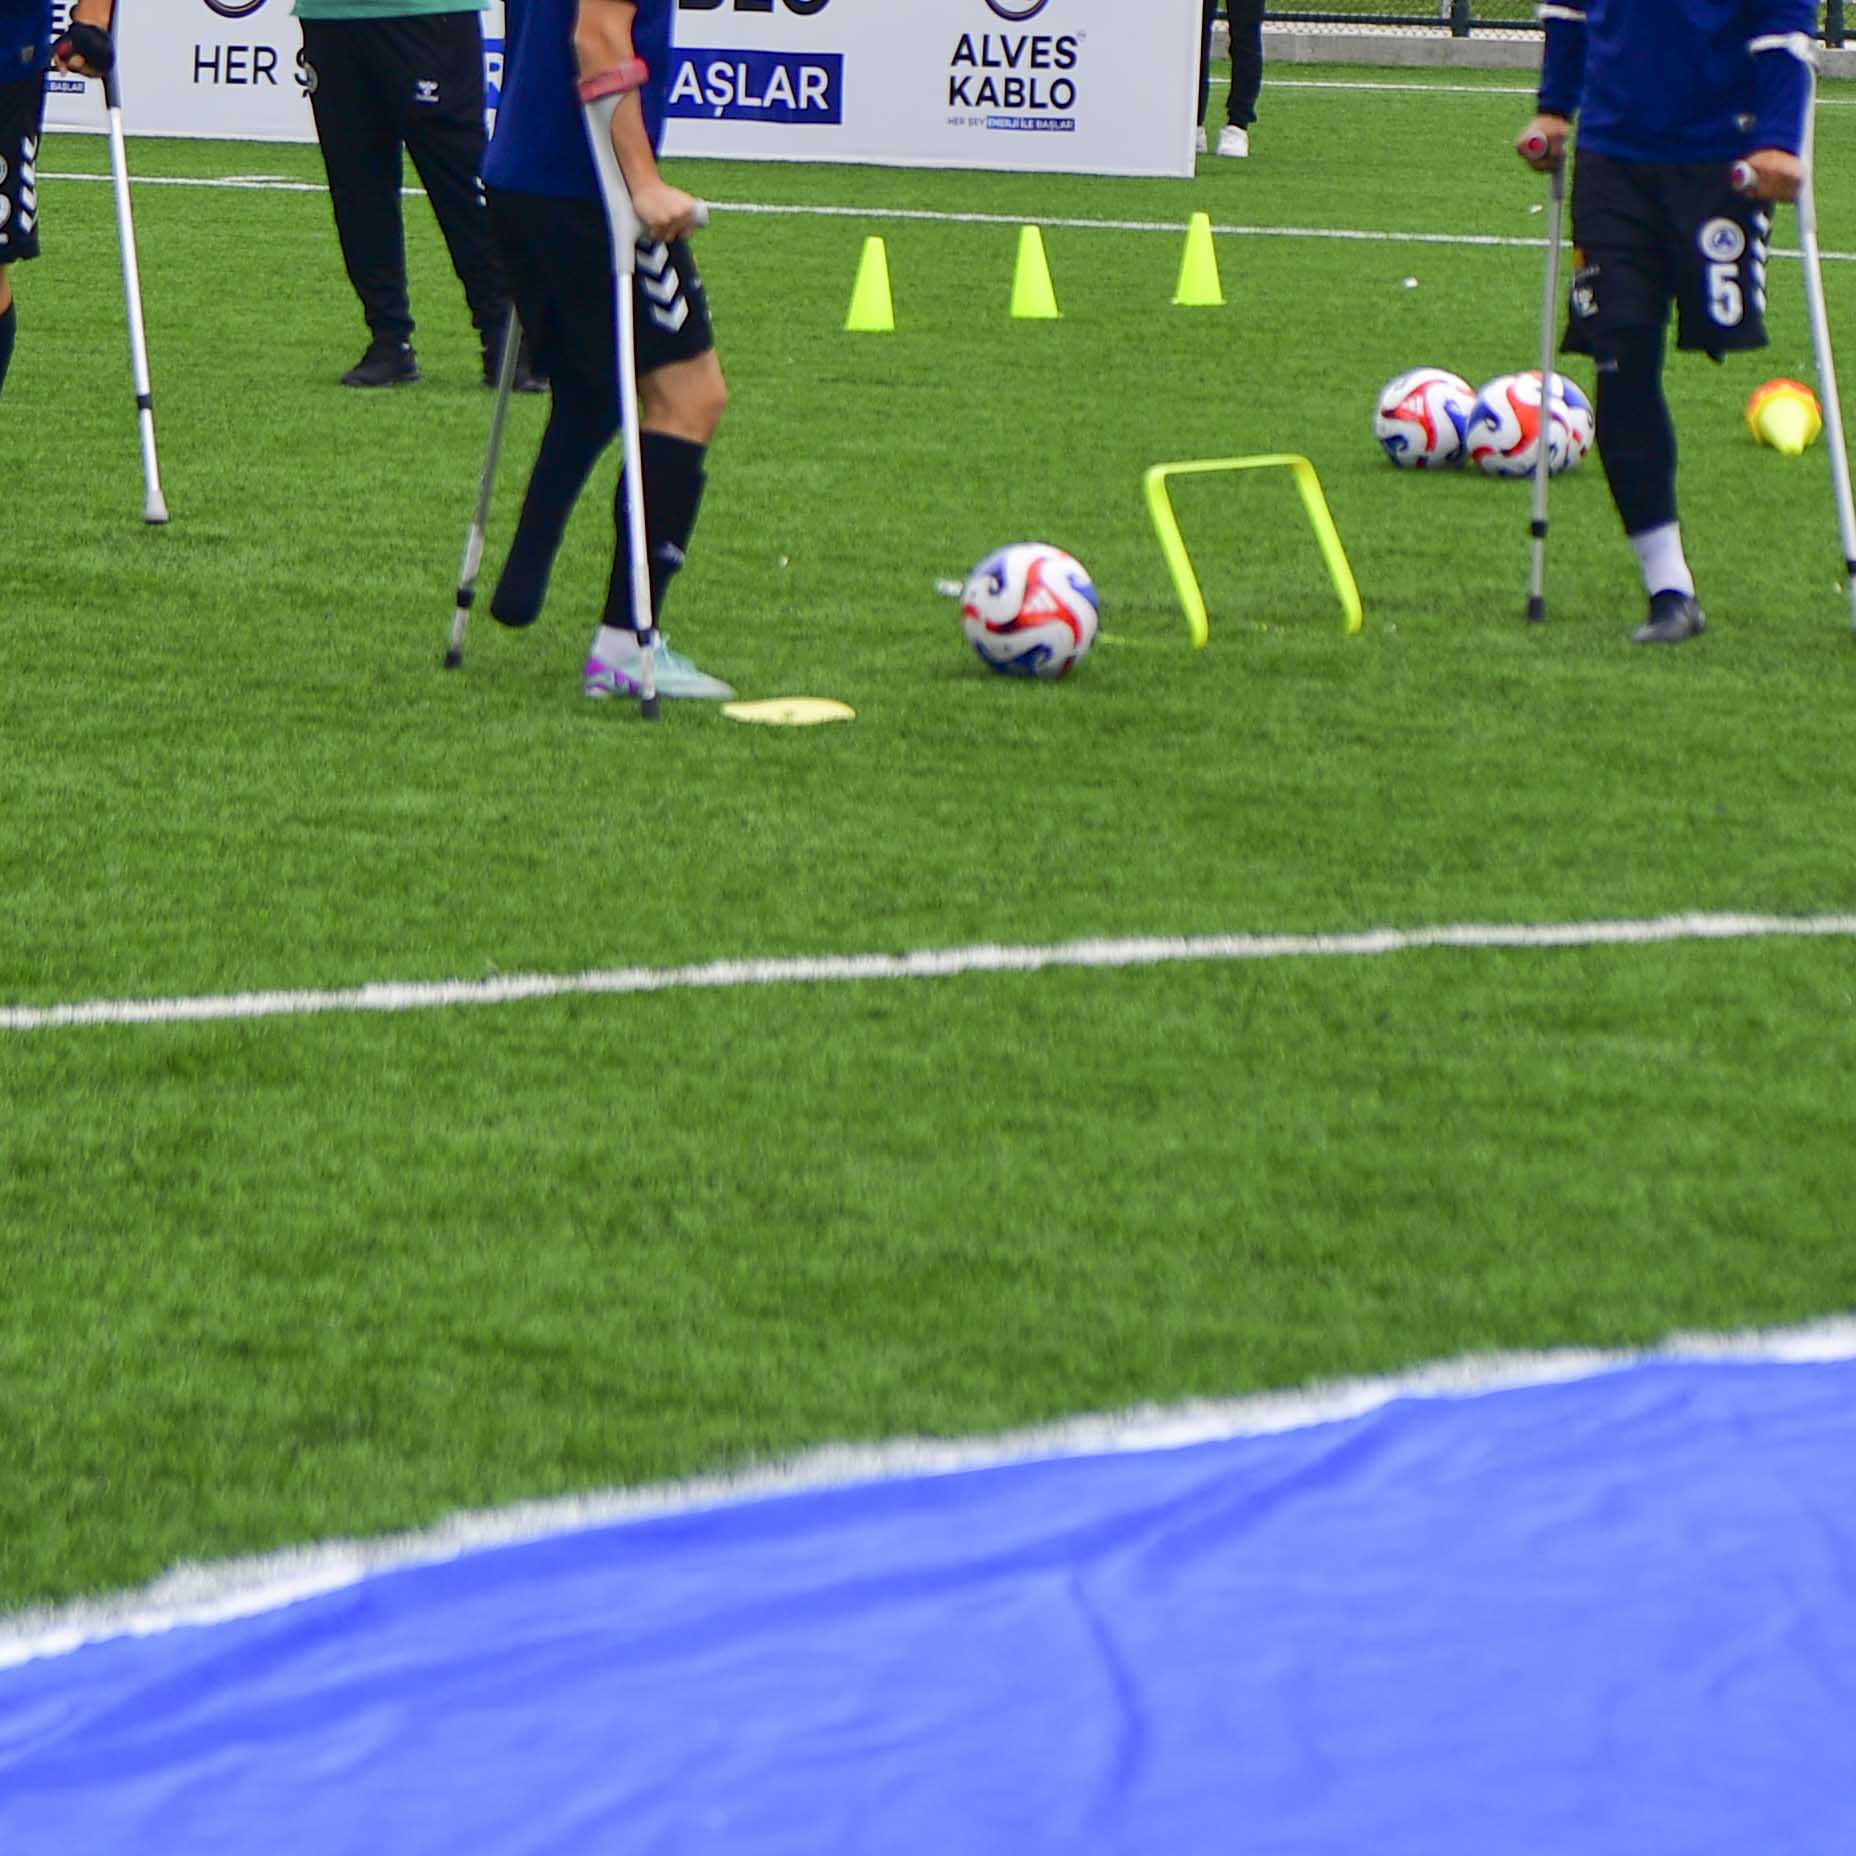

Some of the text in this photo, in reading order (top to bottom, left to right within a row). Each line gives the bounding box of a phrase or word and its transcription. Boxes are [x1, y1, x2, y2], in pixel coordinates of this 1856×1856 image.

[193, 44, 279, 86] HER
[950, 32, 1079, 70] ALVES
[668, 61, 830, 118] AŞLAR
[948, 75, 1078, 111] KABLO
[1708, 262, 1745, 328] 5
